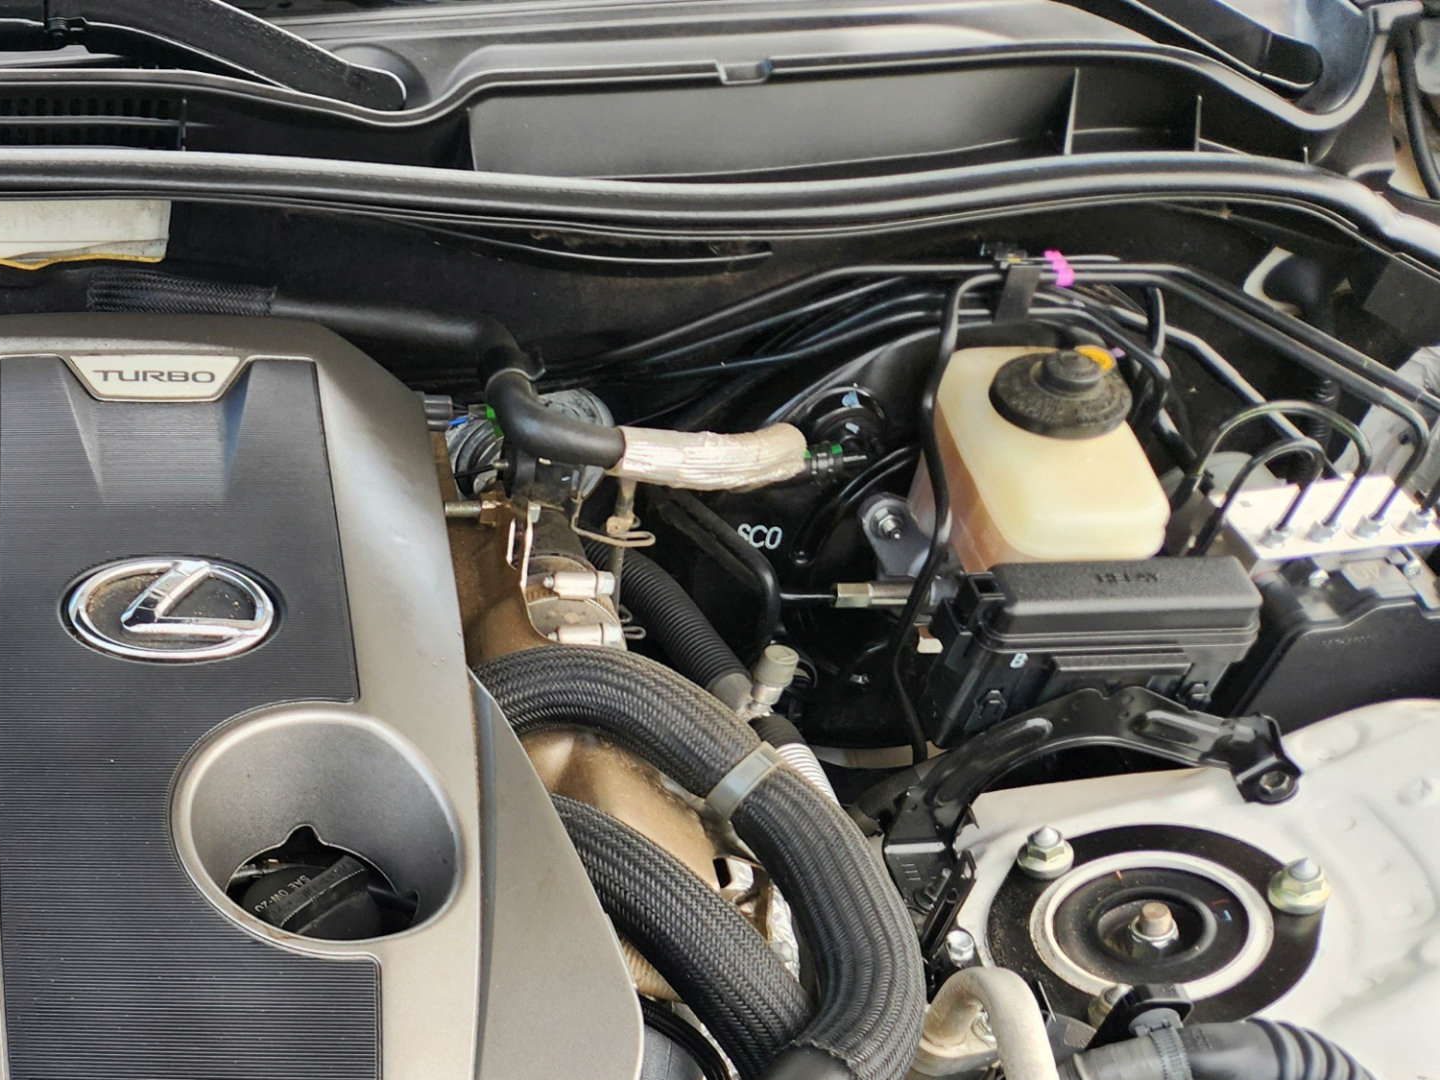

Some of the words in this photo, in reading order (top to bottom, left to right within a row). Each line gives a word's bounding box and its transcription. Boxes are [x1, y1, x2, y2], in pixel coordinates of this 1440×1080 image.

[93, 369, 216, 383] TURBO
[1009, 652, 1029, 669] B
[288, 875, 311, 889] SAE
